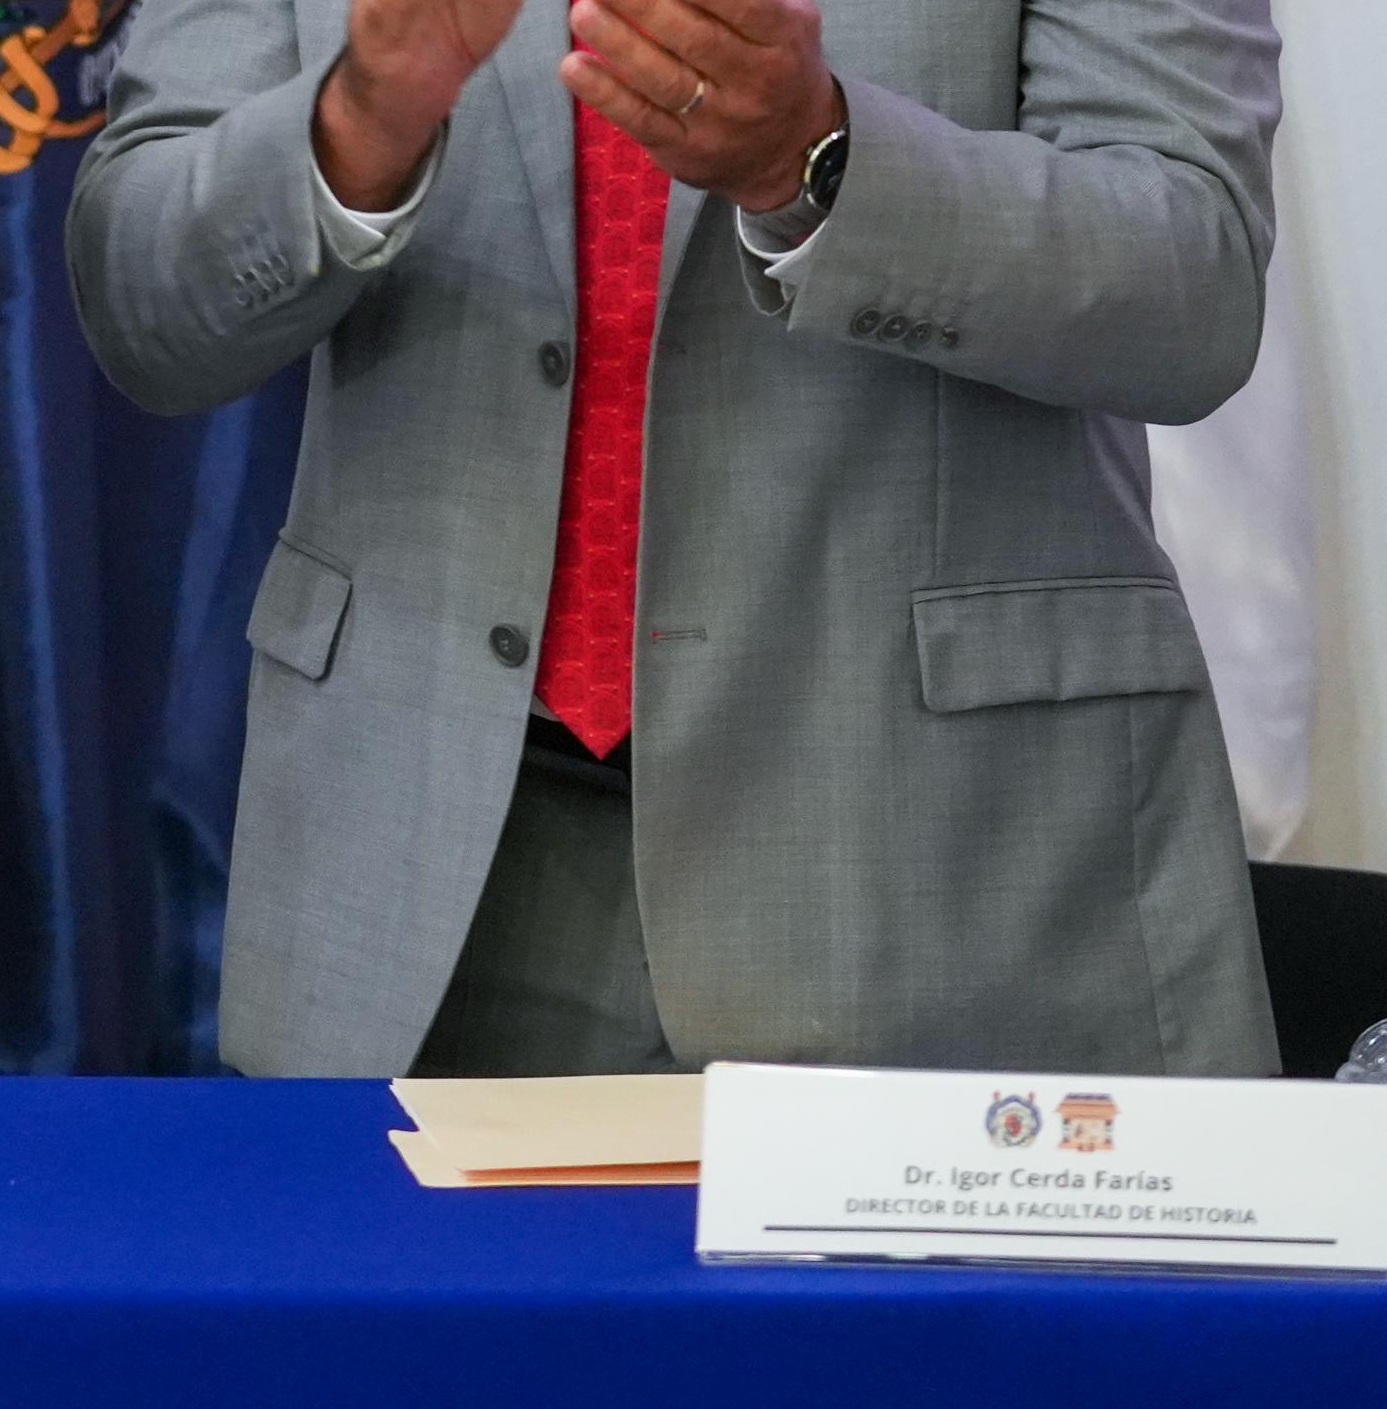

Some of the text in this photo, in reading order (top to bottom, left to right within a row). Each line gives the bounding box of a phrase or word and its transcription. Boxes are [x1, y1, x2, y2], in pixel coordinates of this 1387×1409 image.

[904, 1165, 1174, 1192] Dr. Igor Cerda Farías
[845, 1197, 1258, 1224] DIRECTOR DE LA FACULTAD DE HISTORIA
